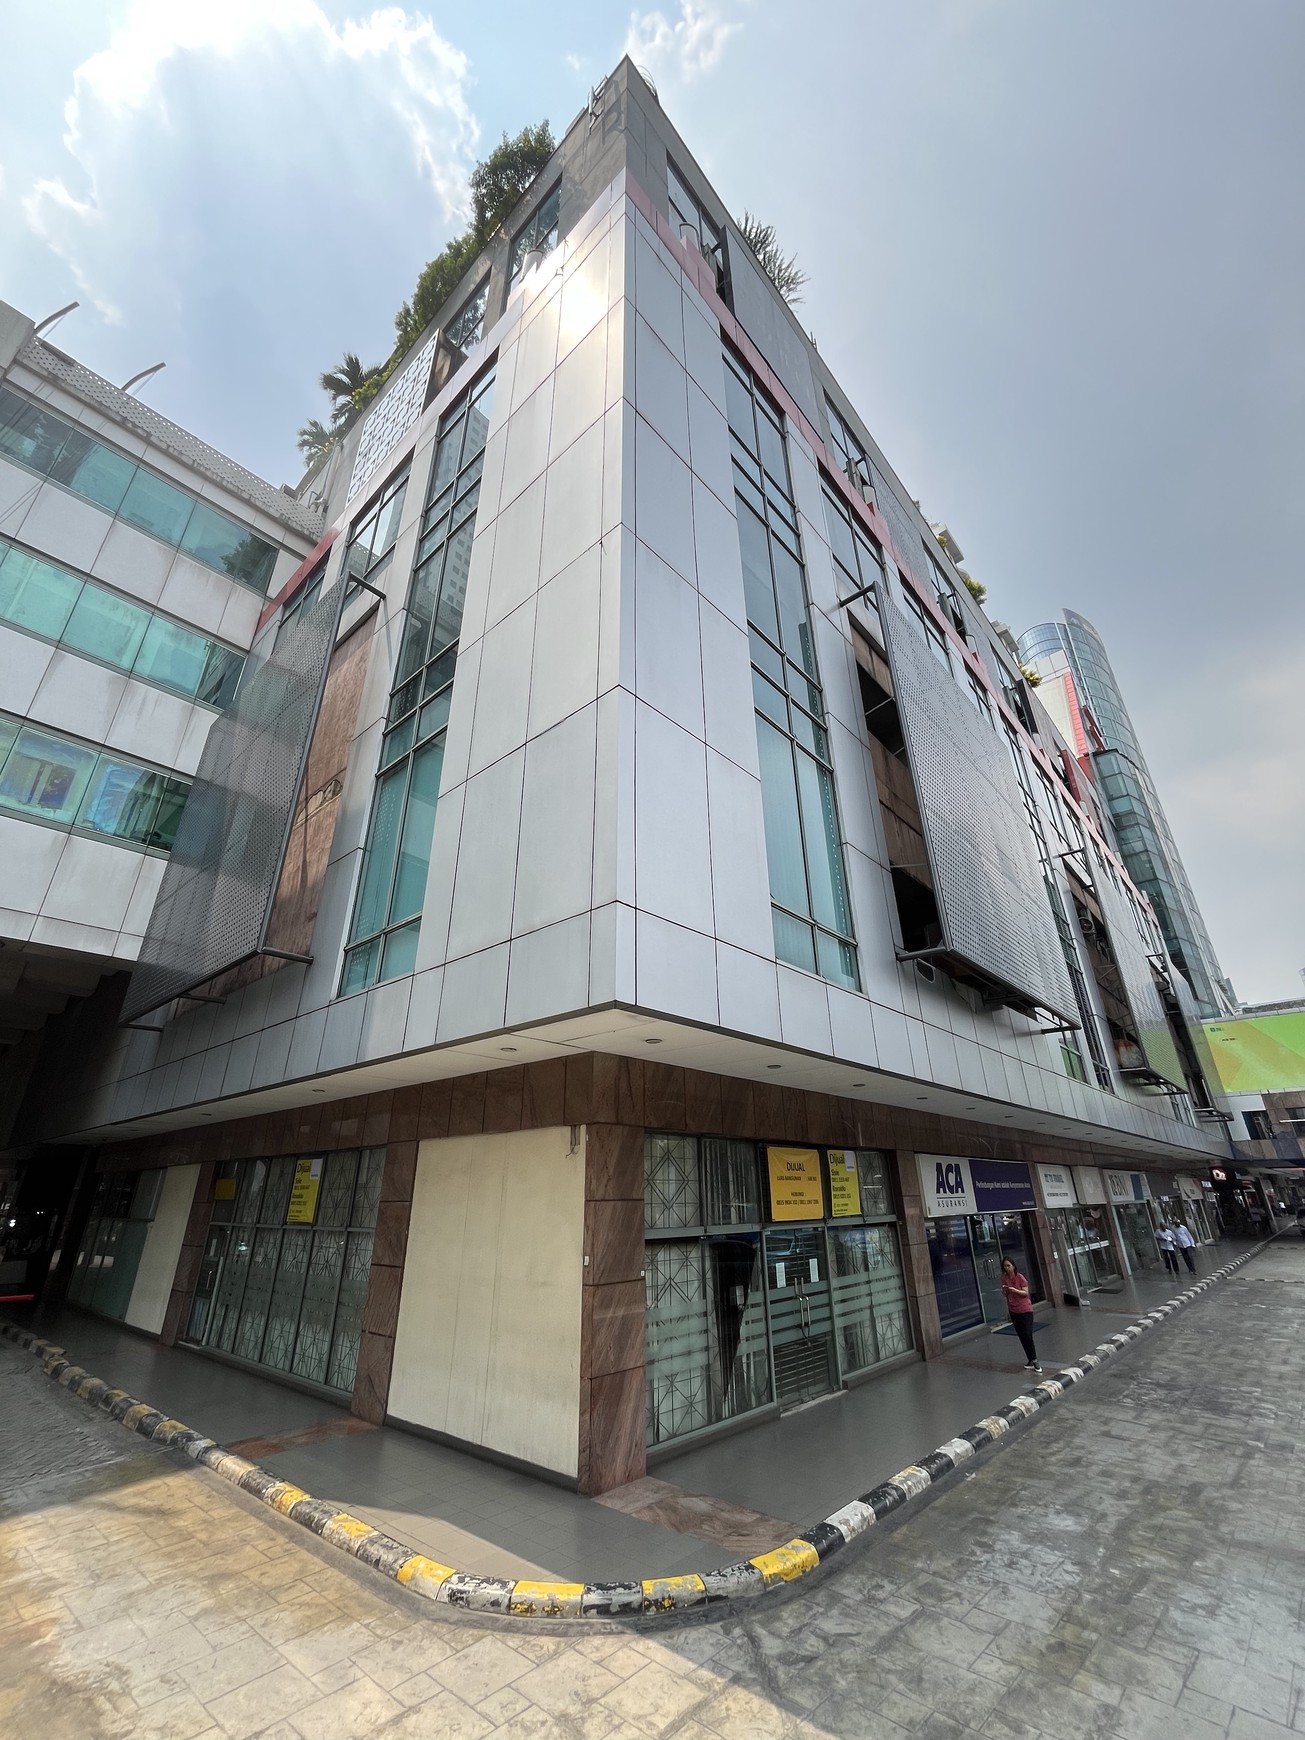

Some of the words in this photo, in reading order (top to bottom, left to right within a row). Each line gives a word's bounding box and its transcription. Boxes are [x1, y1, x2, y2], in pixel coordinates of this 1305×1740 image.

[830, 1153, 845, 1166] Dijual
[297, 1162, 311, 1175] Dijual
[787, 1162, 806, 1172] DIJUAL
[936, 1162, 965, 1194] ACA
[938, 1199, 968, 1208] ASURANSI
